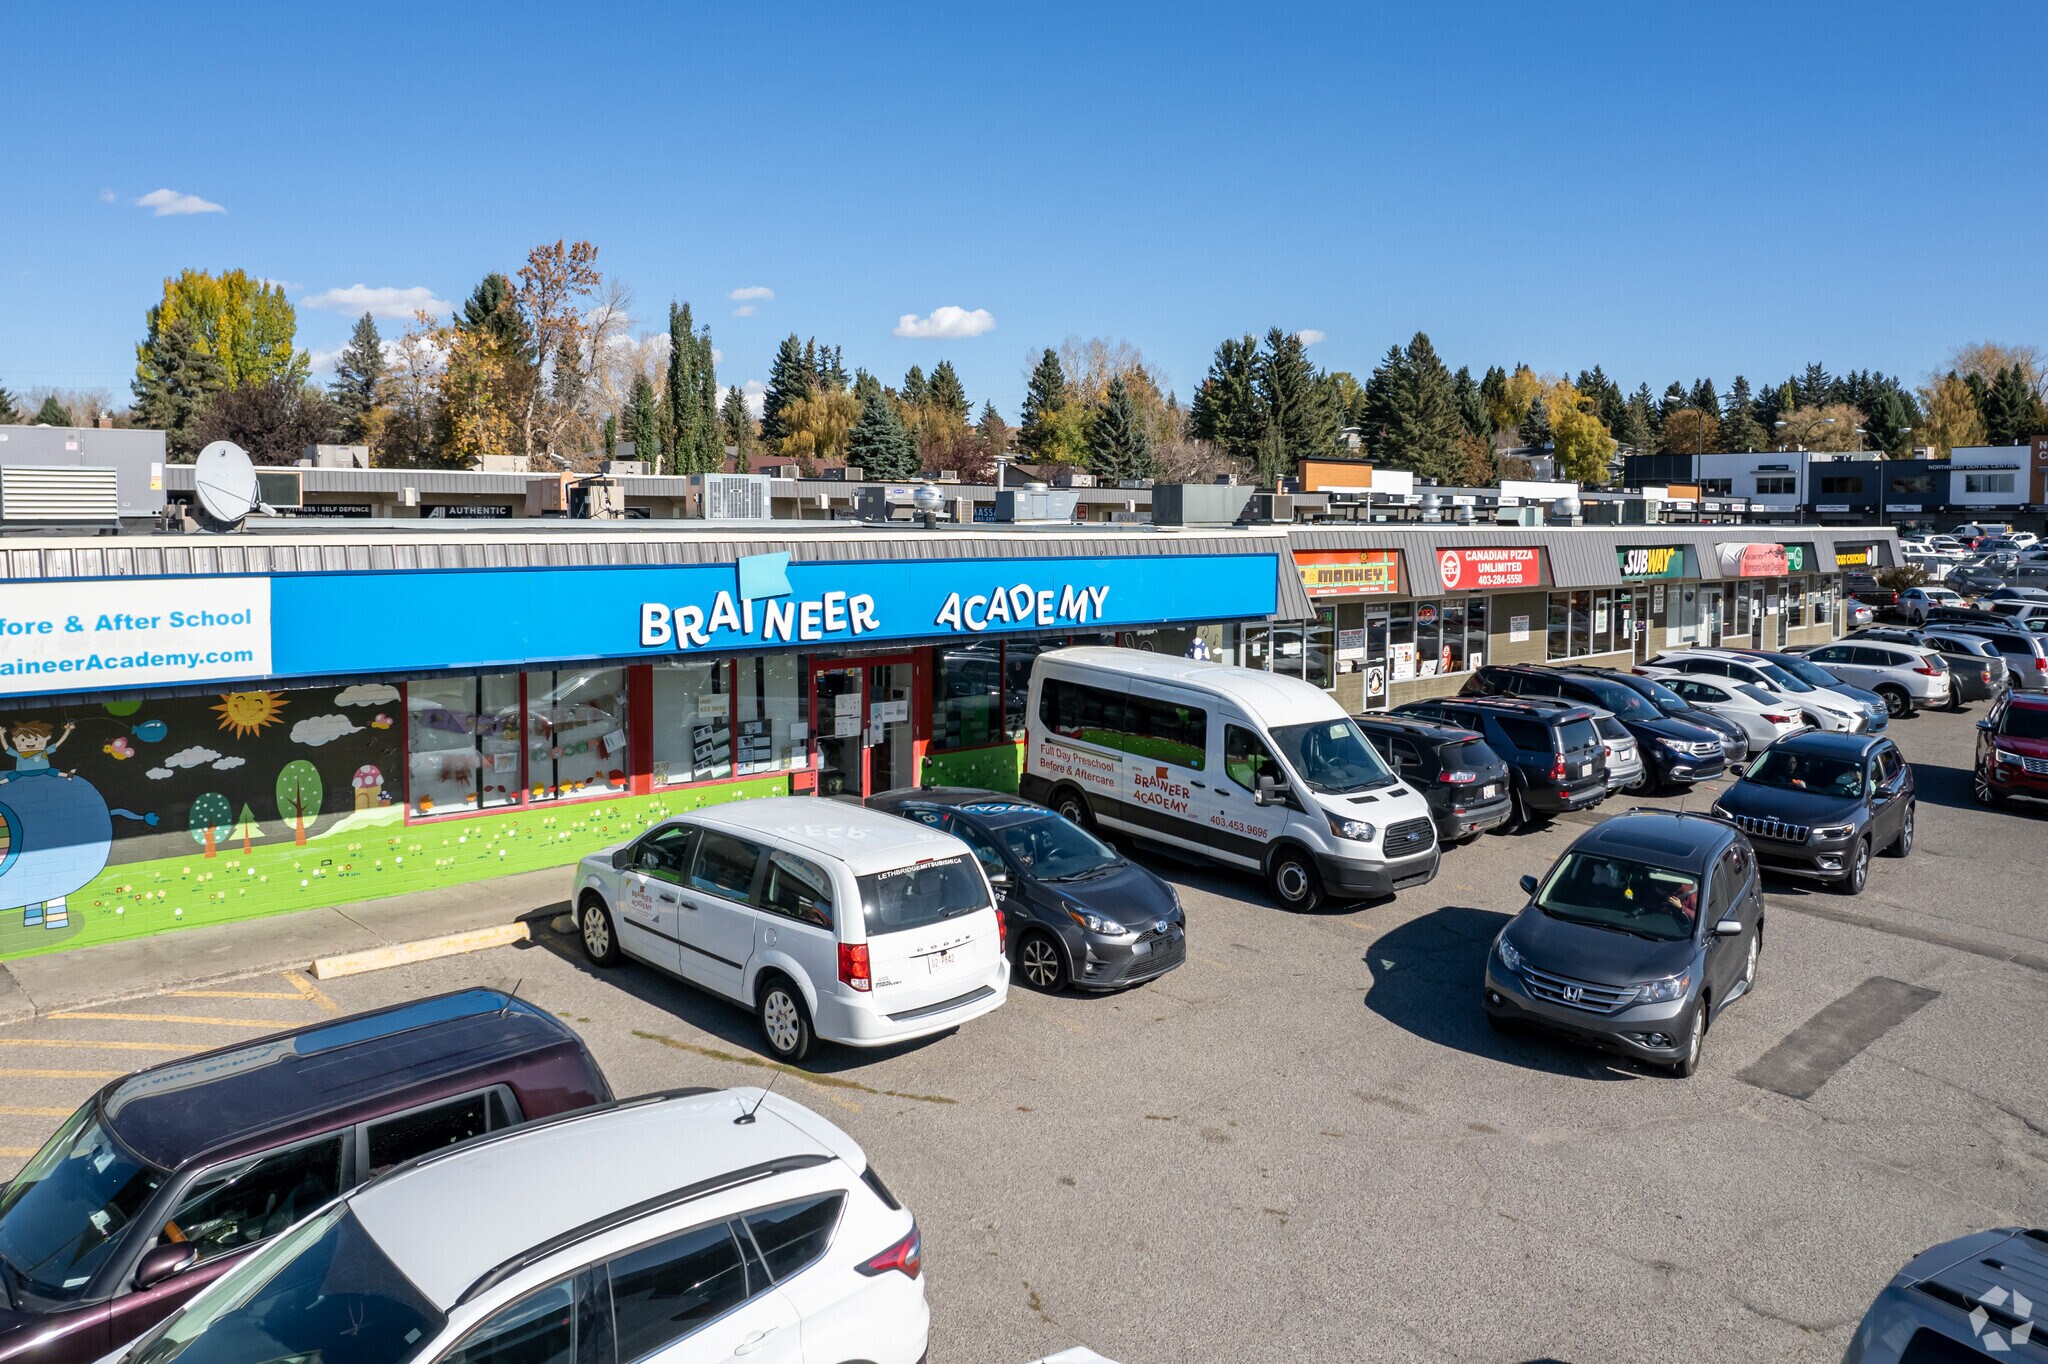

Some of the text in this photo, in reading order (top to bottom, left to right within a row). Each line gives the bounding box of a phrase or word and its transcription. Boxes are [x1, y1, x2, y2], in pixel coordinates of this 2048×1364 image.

[449, 506, 506, 515] AUTHENTIC
[1465, 550, 1533, 561] CANADIAN PIZZA
[1478, 562, 1522, 573] UNLIMITED
[1624, 548, 1675, 574] SUBWAY
[1478, 574, 1522, 585] 403-284-5550
[64, 616, 84, 633] &
[94, 611, 161, 633] After
[169, 608, 252, 629] School
[642, 583, 1109, 649] BRAINEER ACADEMY
[1040, 744, 1115, 773] Full Day Preschool
[1040, 758, 1115, 787] Before & Aftercare
[1134, 774, 1191, 799] BRAINEER
[1133, 789, 1189, 814] ACADEMY
[1210, 815, 1269, 839] 403.453.9696
